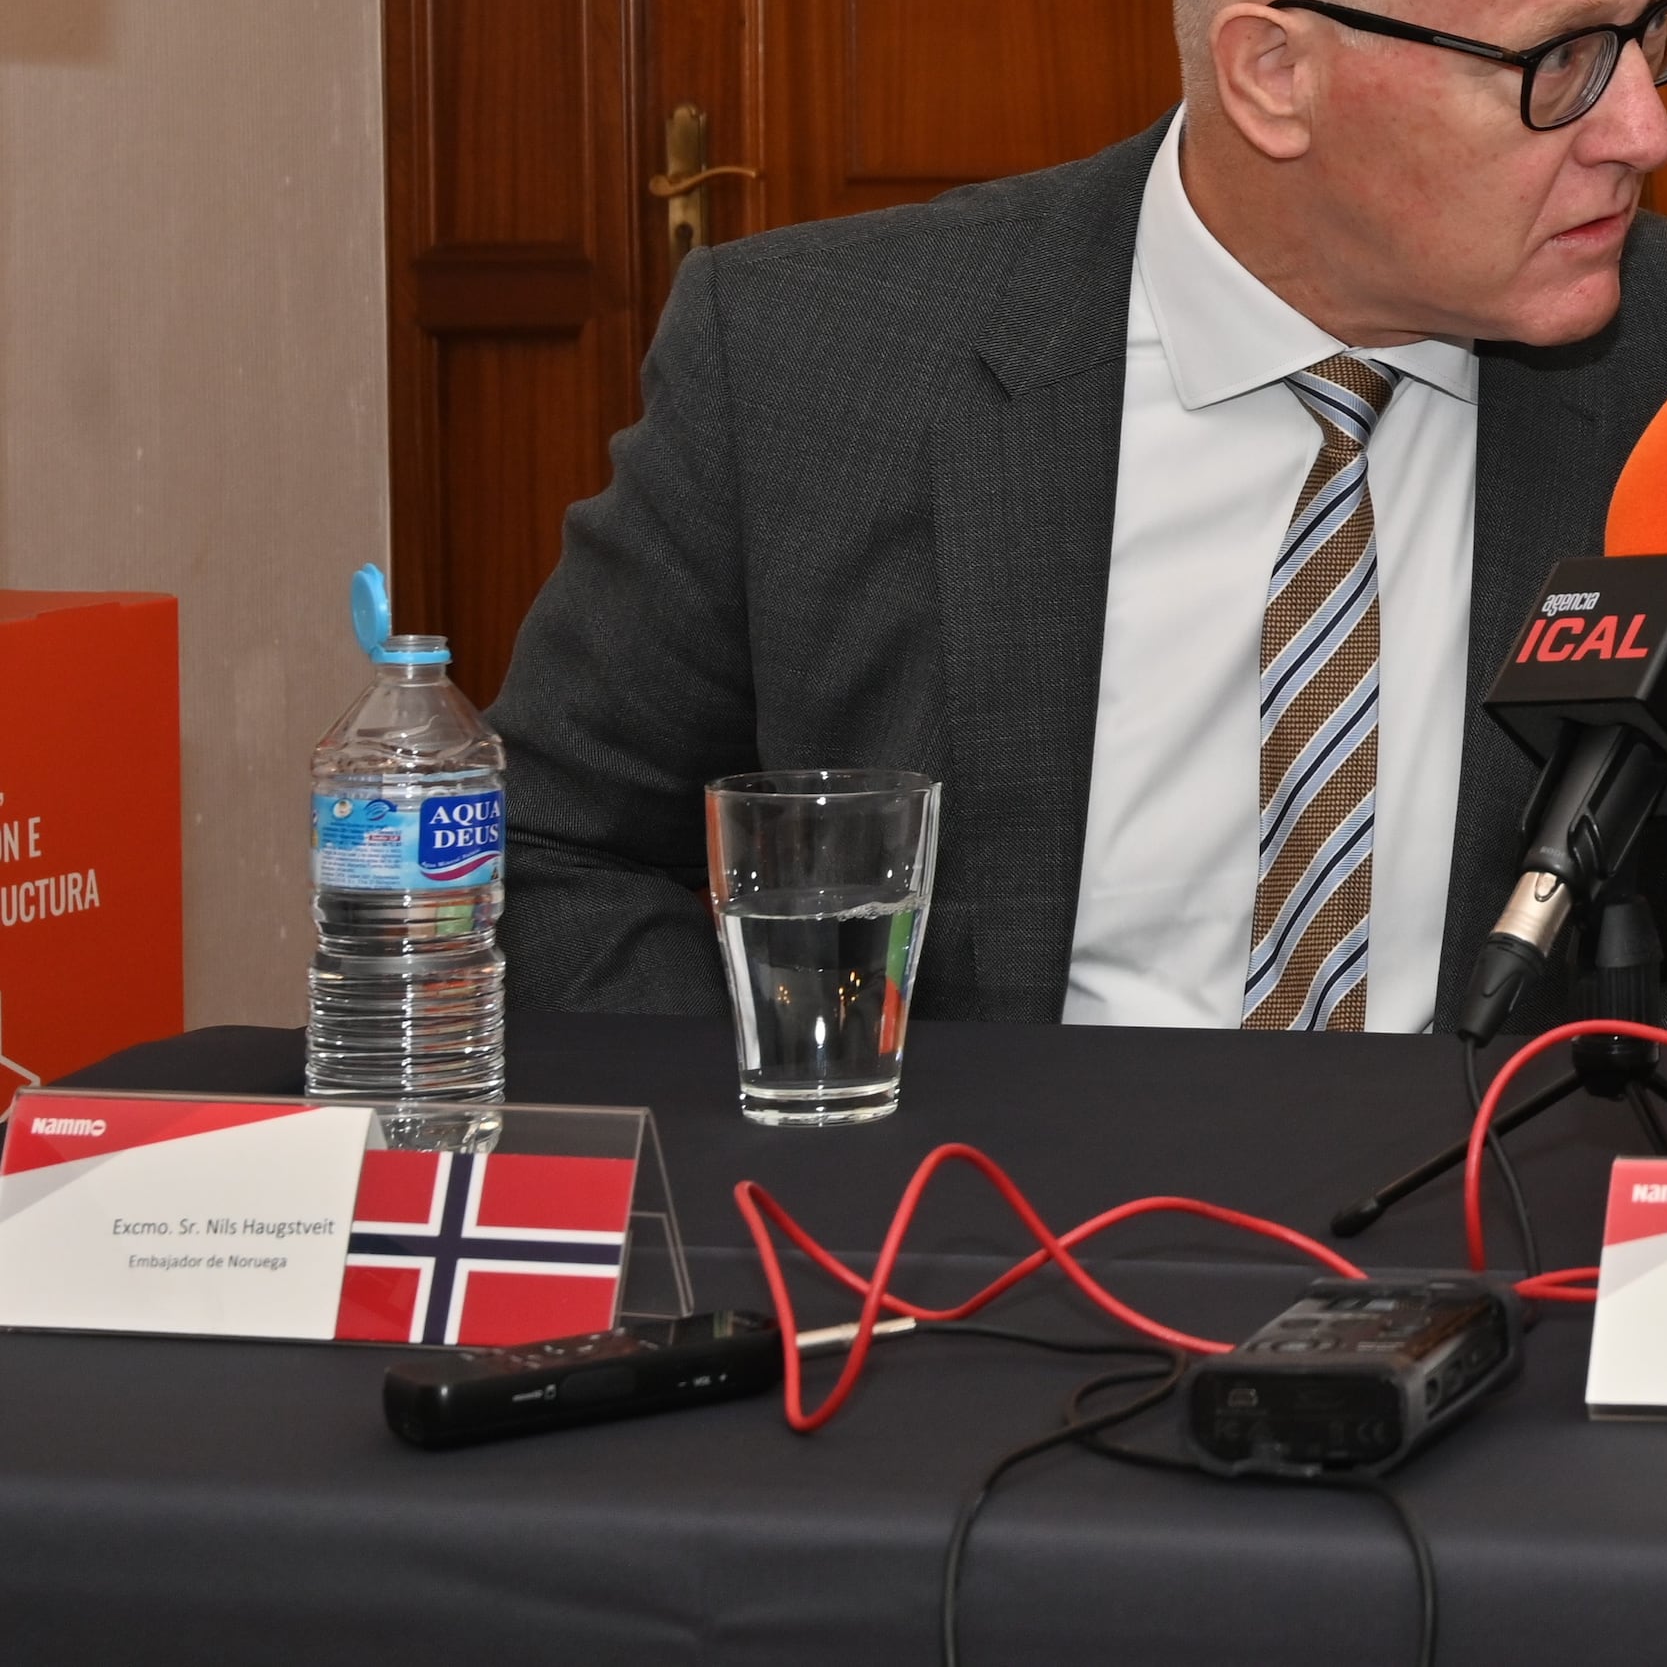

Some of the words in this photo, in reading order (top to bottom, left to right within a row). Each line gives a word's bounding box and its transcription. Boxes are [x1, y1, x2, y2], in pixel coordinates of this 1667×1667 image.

[1541, 591, 1601, 617] agencia
[1515, 613, 1649, 664] ICAL
[428, 800, 501, 827] AQUA
[28, 816, 42, 859] E
[432, 824, 500, 850] DEUS
[0, 868, 101, 927] UCTURA
[30, 1117, 108, 1137] Nammo
[112, 1218, 173, 1236] Excmo.
[178, 1218, 201, 1235] Sr.
[205, 1218, 237, 1235] Nils
[242, 1218, 335, 1239] Haugstveit
[128, 1254, 203, 1271] Embajador
[206, 1254, 224, 1269] de
[227, 1255, 288, 1272] Noruega
